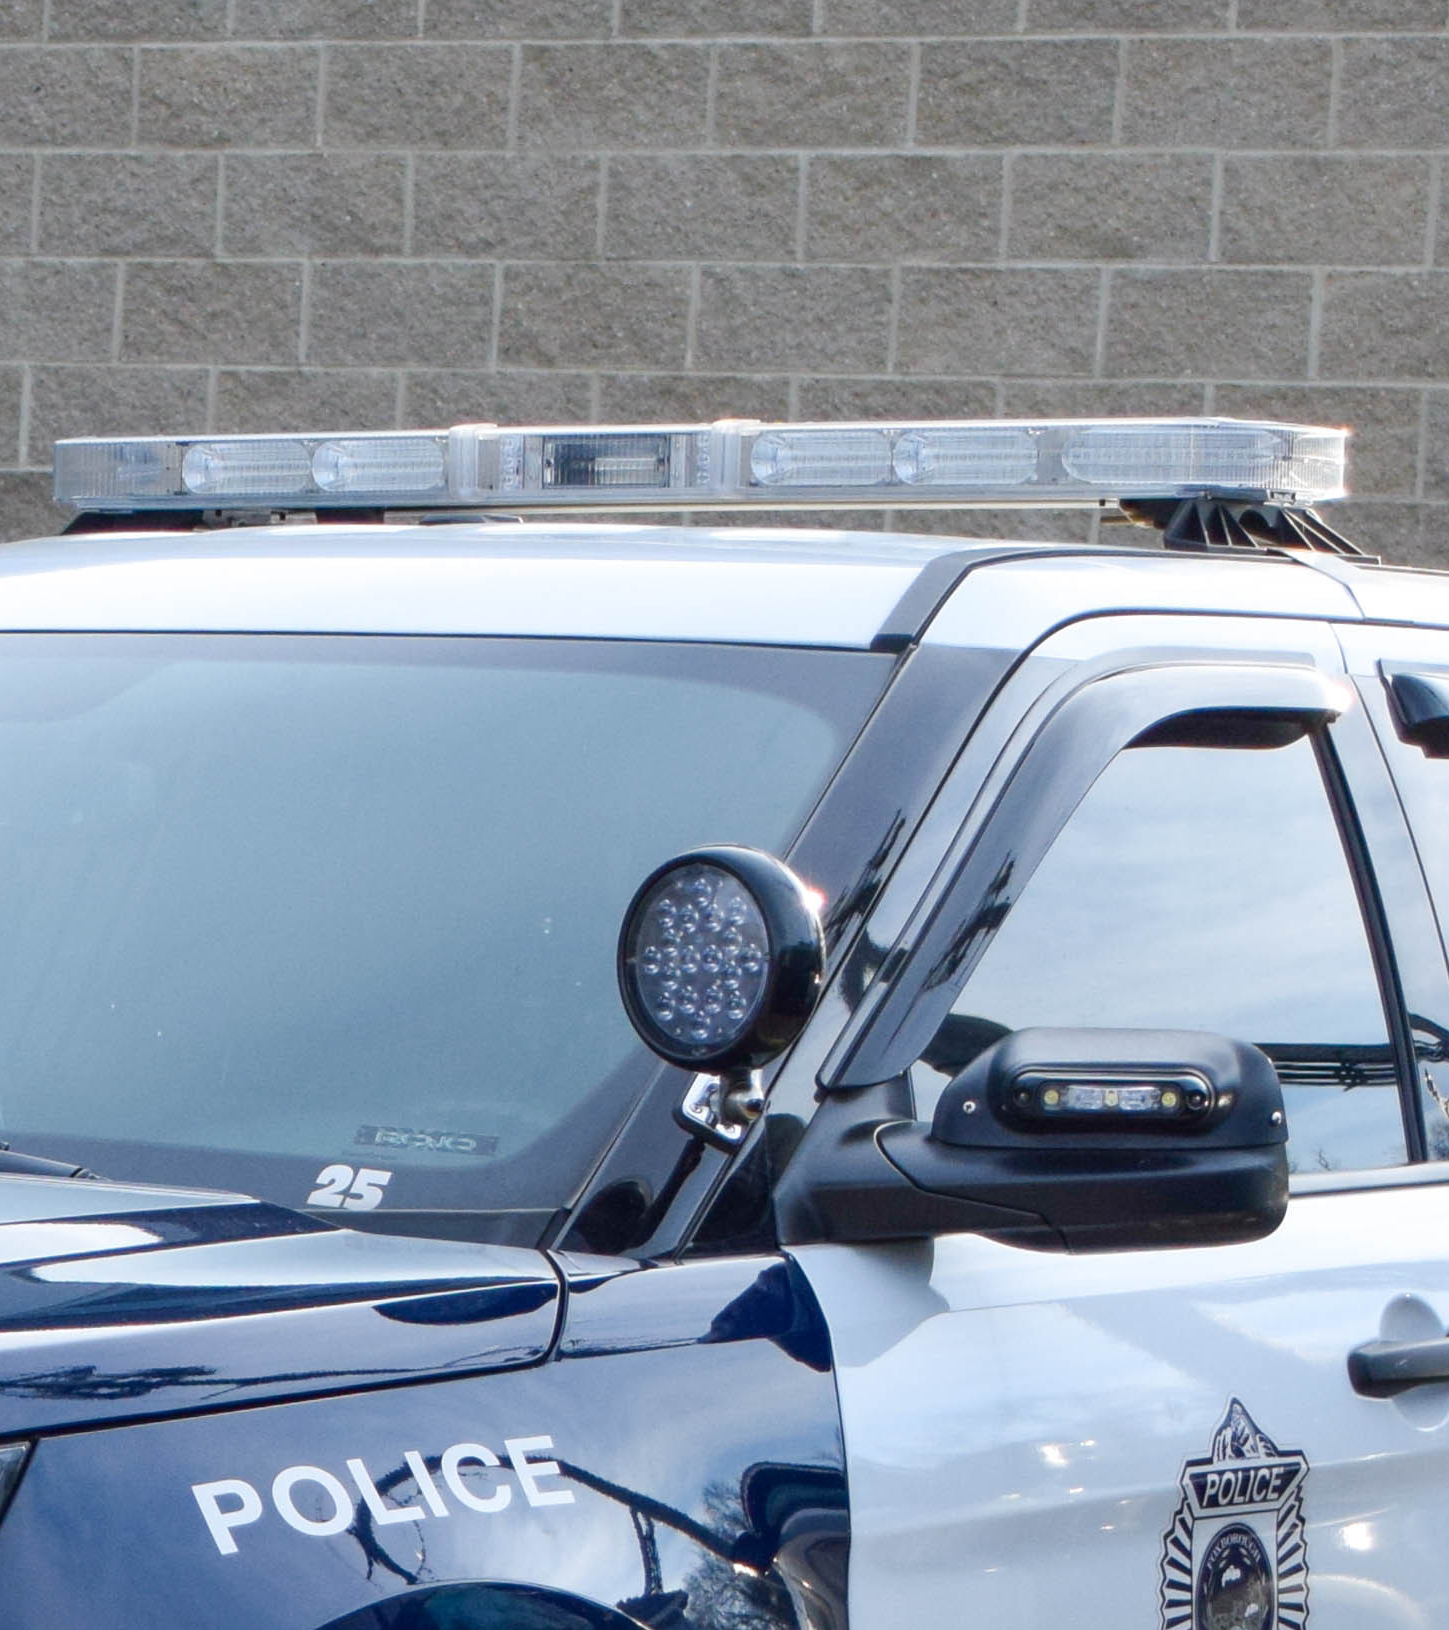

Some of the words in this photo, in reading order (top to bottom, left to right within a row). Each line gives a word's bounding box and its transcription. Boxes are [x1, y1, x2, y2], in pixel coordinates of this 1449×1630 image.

[306, 1163, 393, 1211] 25
[191, 1434, 576, 1556] POLICE
[1202, 1466, 1286, 1507] POLICE
